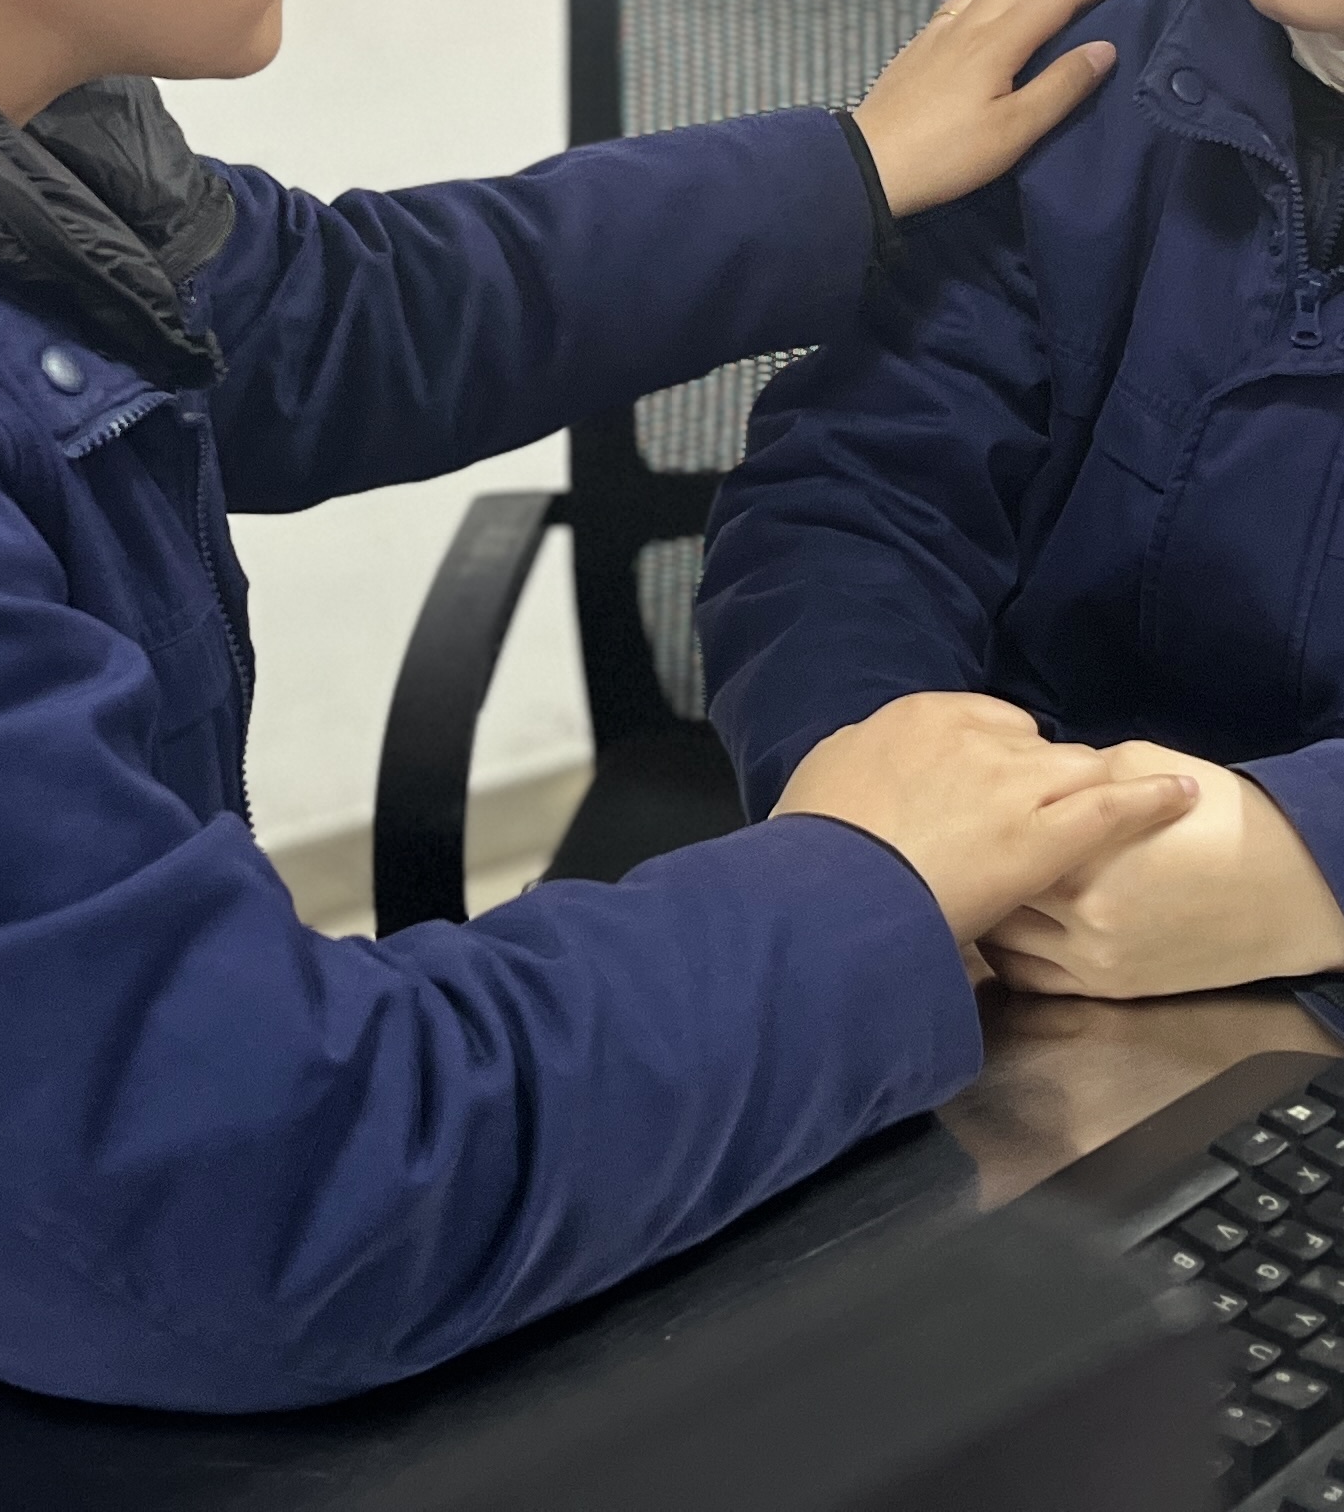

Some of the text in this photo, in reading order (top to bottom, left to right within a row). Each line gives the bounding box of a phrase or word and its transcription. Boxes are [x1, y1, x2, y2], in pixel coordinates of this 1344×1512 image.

[1297, 1166, 1320, 1182] X
[1258, 1194, 1279, 1210] C
[1217, 1224, 1239, 1240] V
[1172, 1251, 1196, 1269] B
[1212, 1294, 1238, 1312] H
